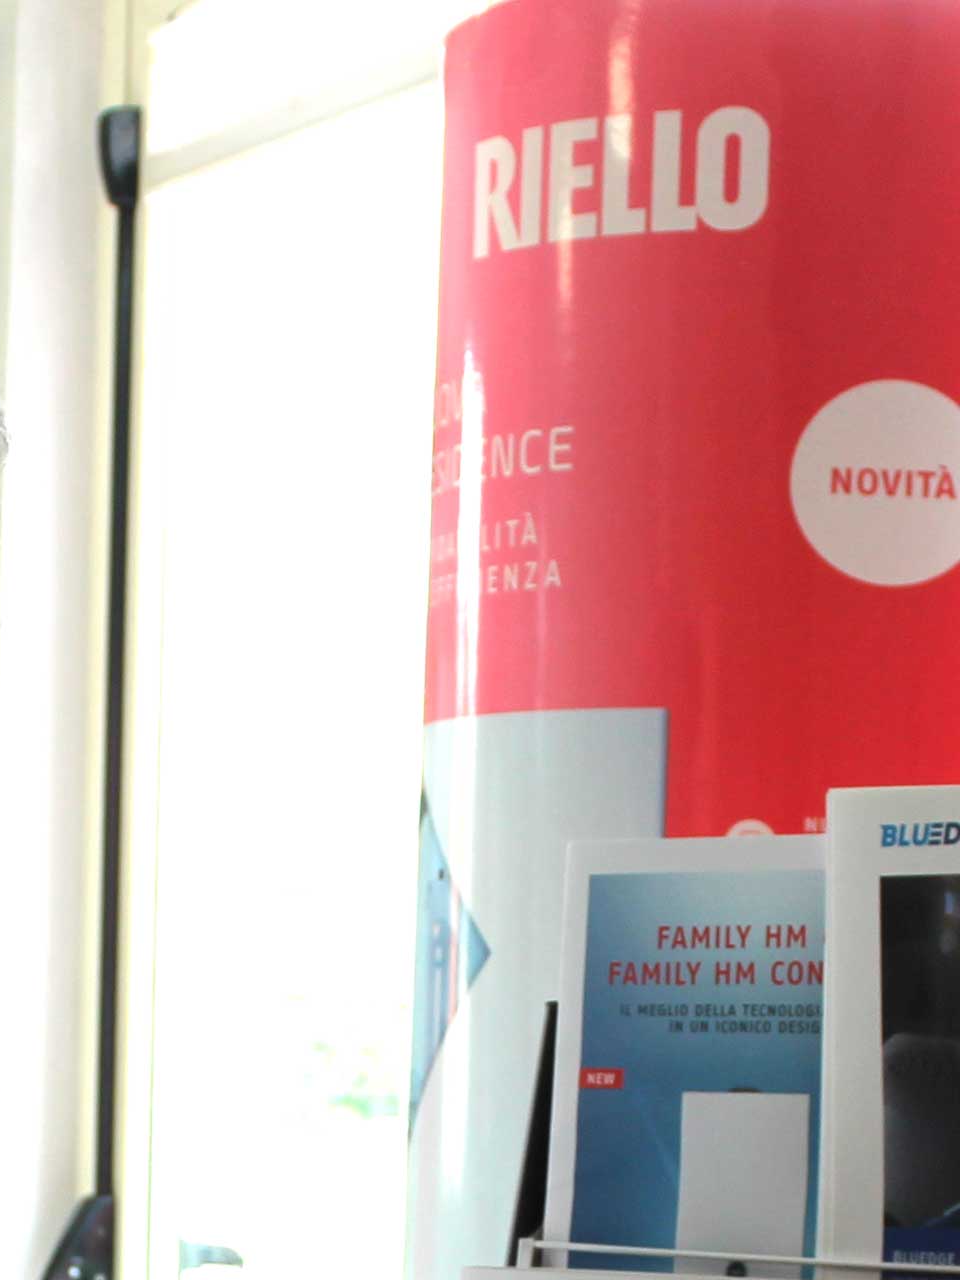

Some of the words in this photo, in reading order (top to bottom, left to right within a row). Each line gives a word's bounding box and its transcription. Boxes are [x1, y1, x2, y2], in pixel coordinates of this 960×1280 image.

[473, 105, 771, 260] RIELLO
[830, 464, 957, 500] NOVITÀ
[657, 925, 752, 950] FAMILY
[765, 924, 807, 949] HM
[608, 961, 701, 986] FAMILY
[714, 961, 756, 986] HM
[638, 1004, 689, 1018] MEGLIO
[695, 1004, 737, 1018] DELLA
[742, 1004, 824, 1018] TECNOLOGI
[715, 1019, 772, 1034] ICONICO
[586, 1071, 616, 1086] NEW
